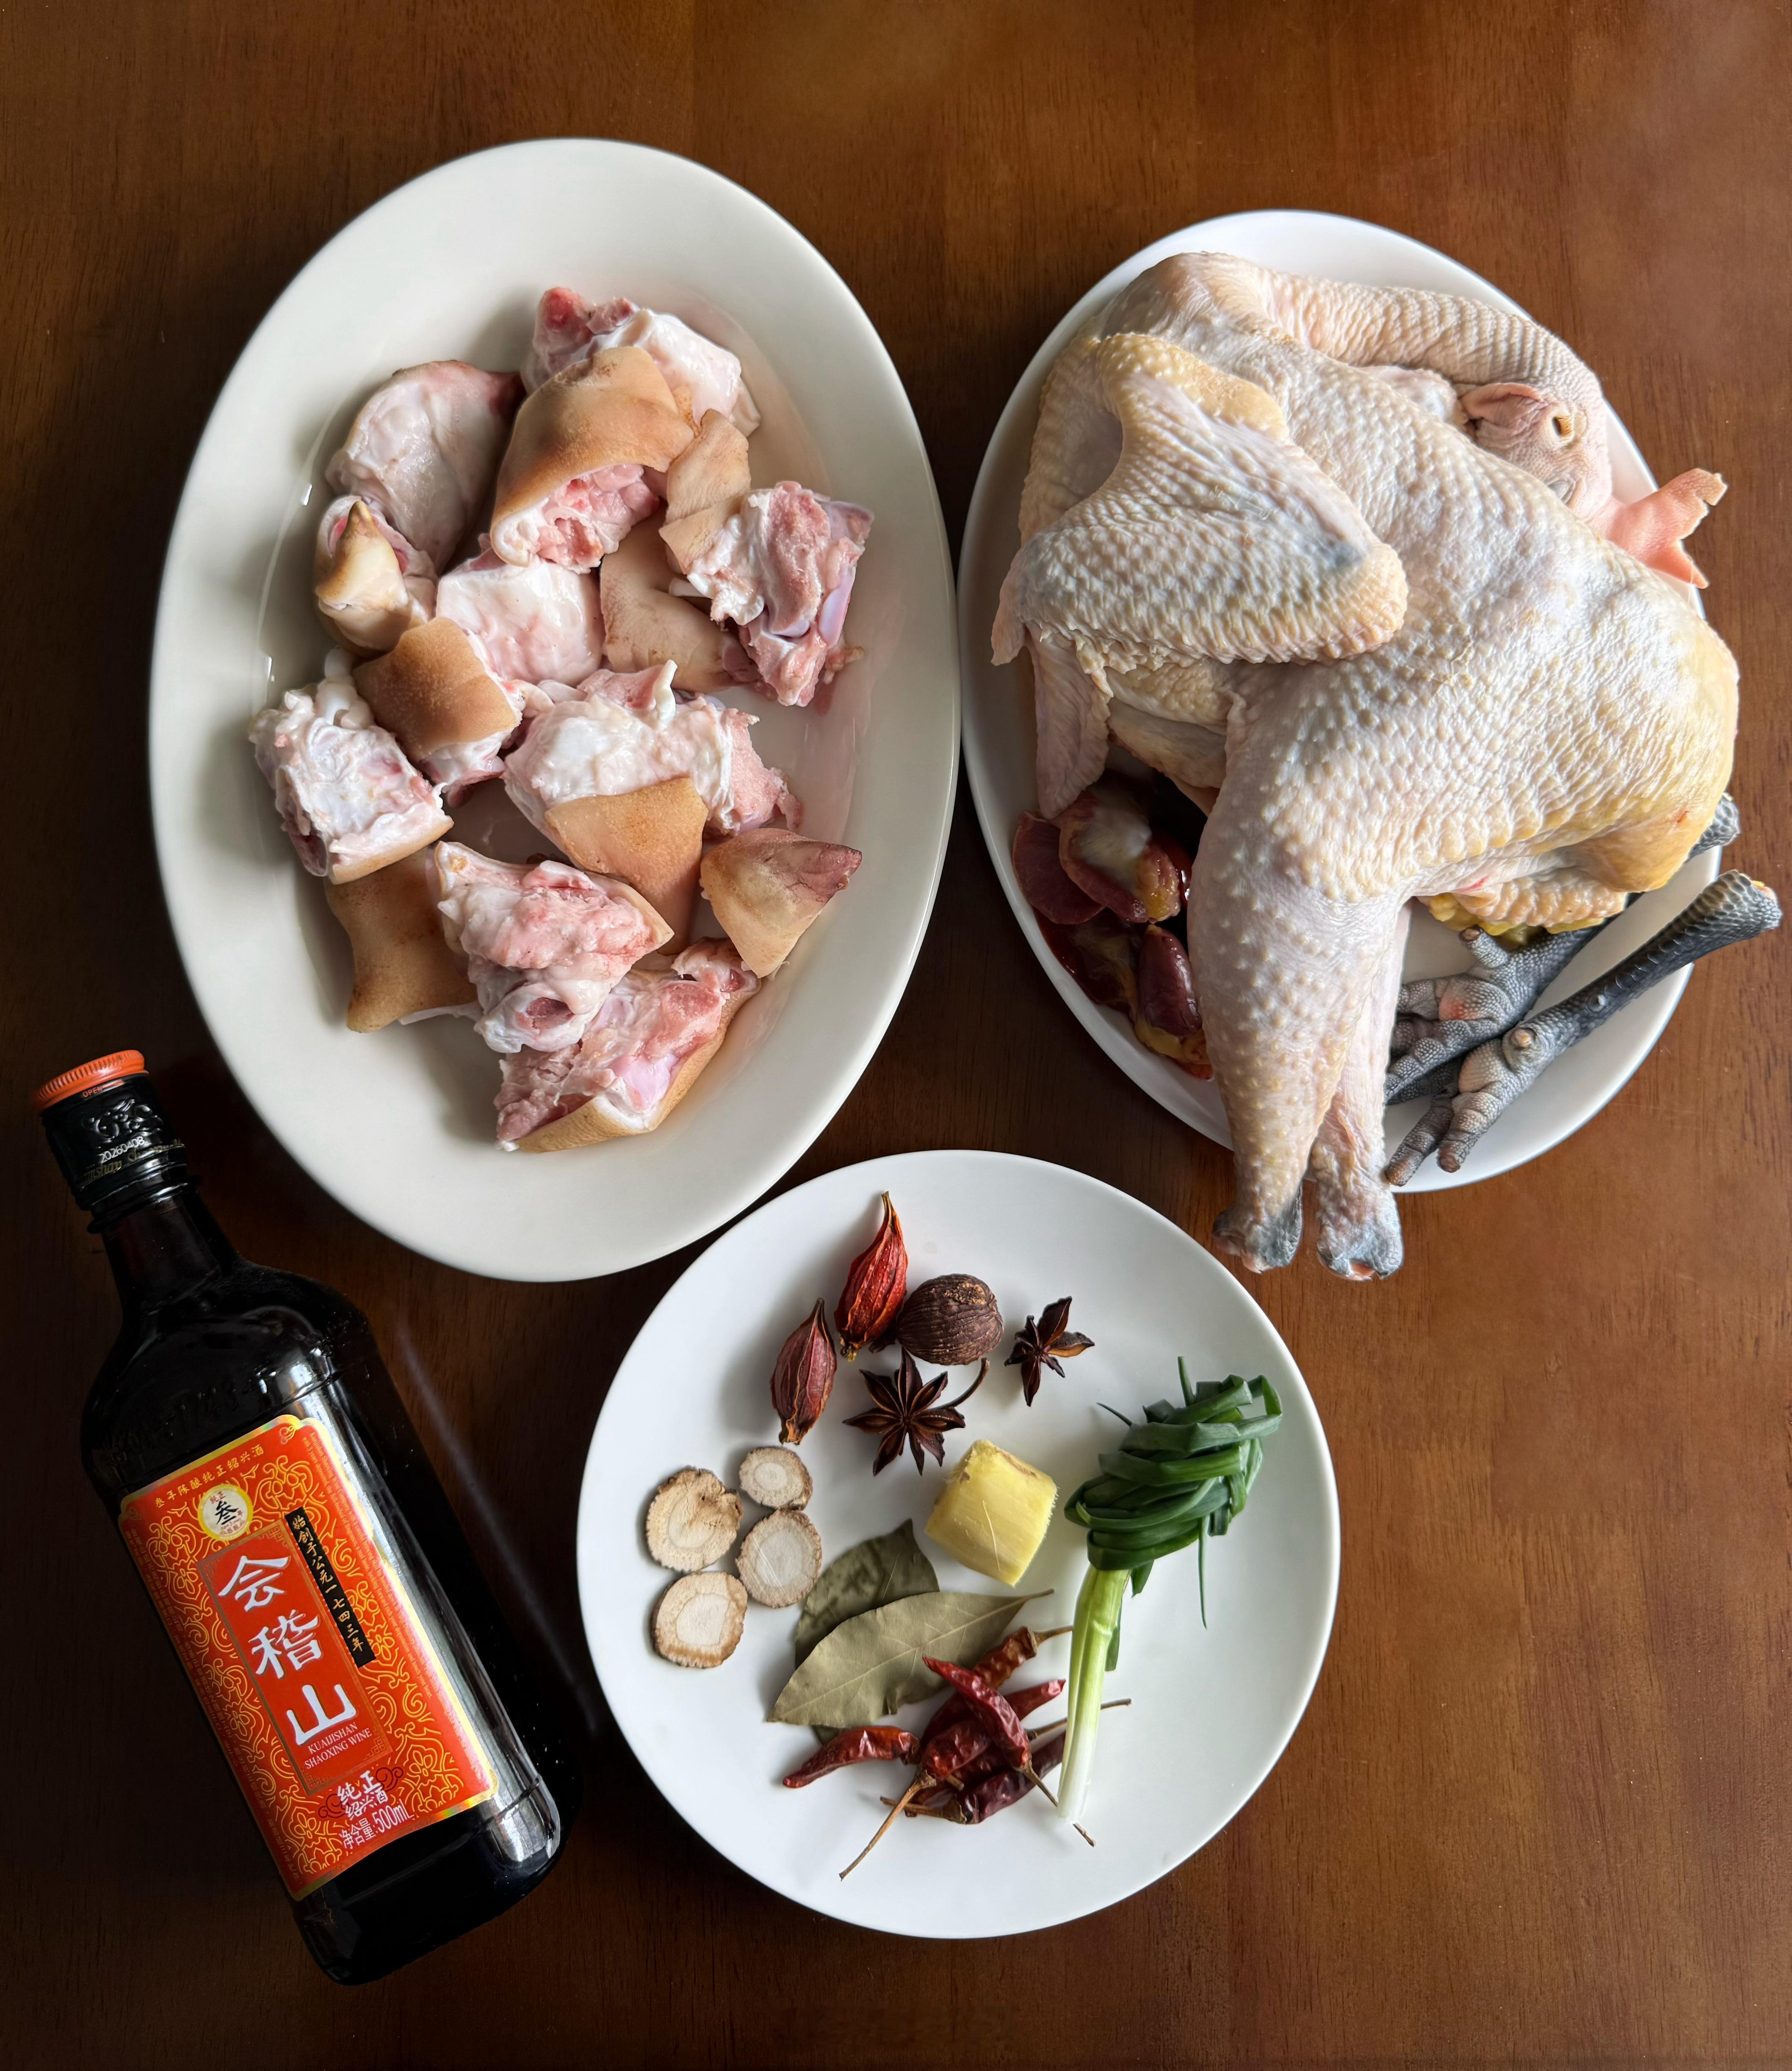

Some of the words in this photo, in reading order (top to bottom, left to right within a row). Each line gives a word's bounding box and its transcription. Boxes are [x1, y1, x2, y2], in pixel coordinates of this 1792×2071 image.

[82, 1086, 103, 1098] OPEN
[99, 1136, 145, 1163] 20260408
[292, 1515, 364, 1652] 始创于公元一七四三年
[218, 1555, 357, 1746] 会稽山
[304, 1740, 348, 1769] SHAOXING
[348, 1728, 372, 1745] WINE
[308, 1722, 358, 1754] KUAIJISHAN
[337, 1770, 381, 1805] 纯正
[346, 1786, 388, 1821] 绍兴酒
